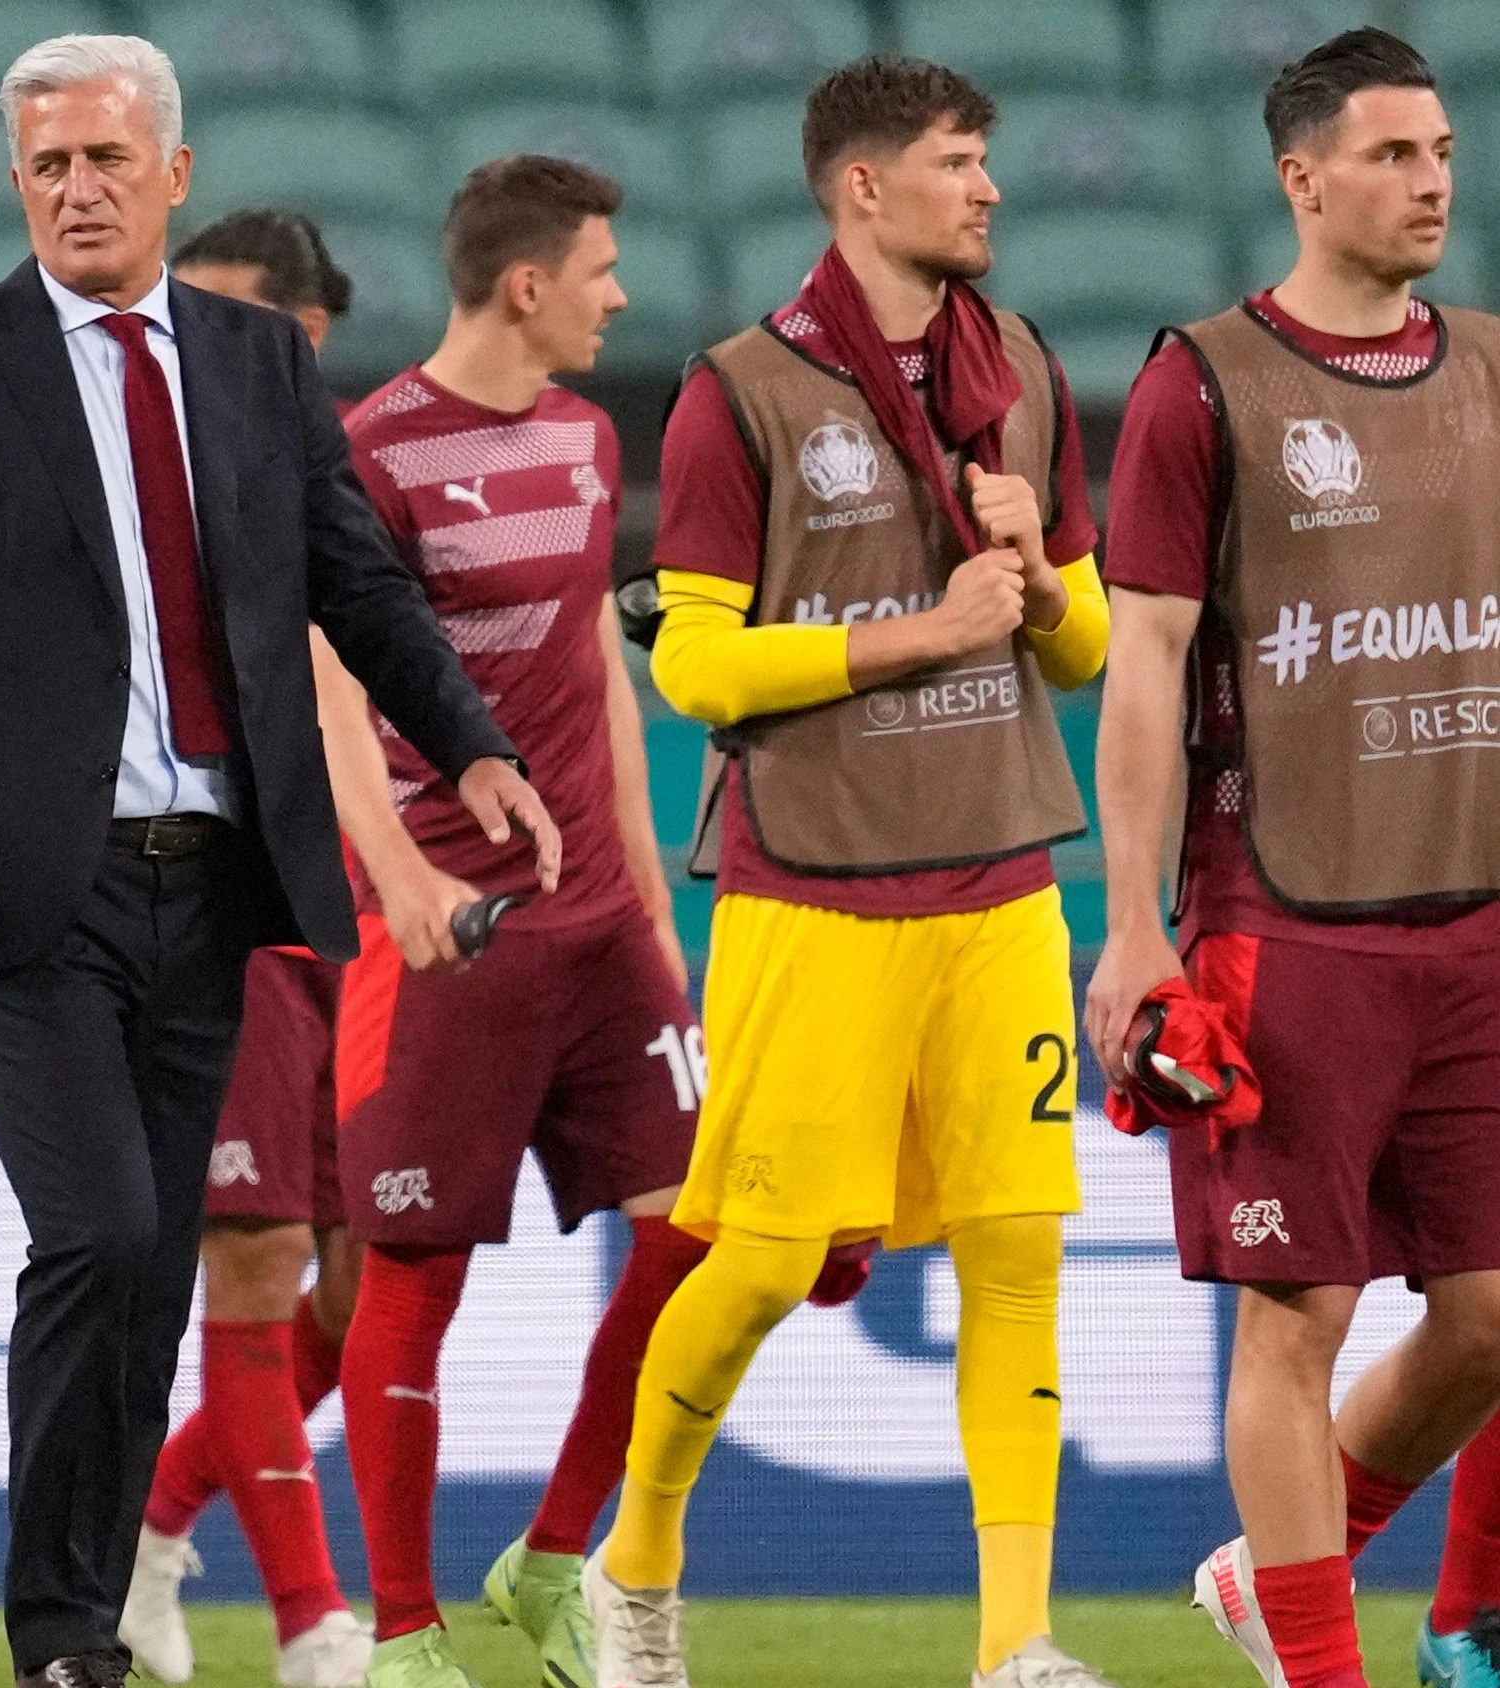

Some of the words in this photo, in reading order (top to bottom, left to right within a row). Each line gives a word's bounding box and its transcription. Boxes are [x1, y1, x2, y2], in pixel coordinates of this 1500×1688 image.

[1256, 594, 1500, 686] #EQUALG
[918, 672, 1019, 718] RESPE
[1025, 1032, 1077, 1123] 2
